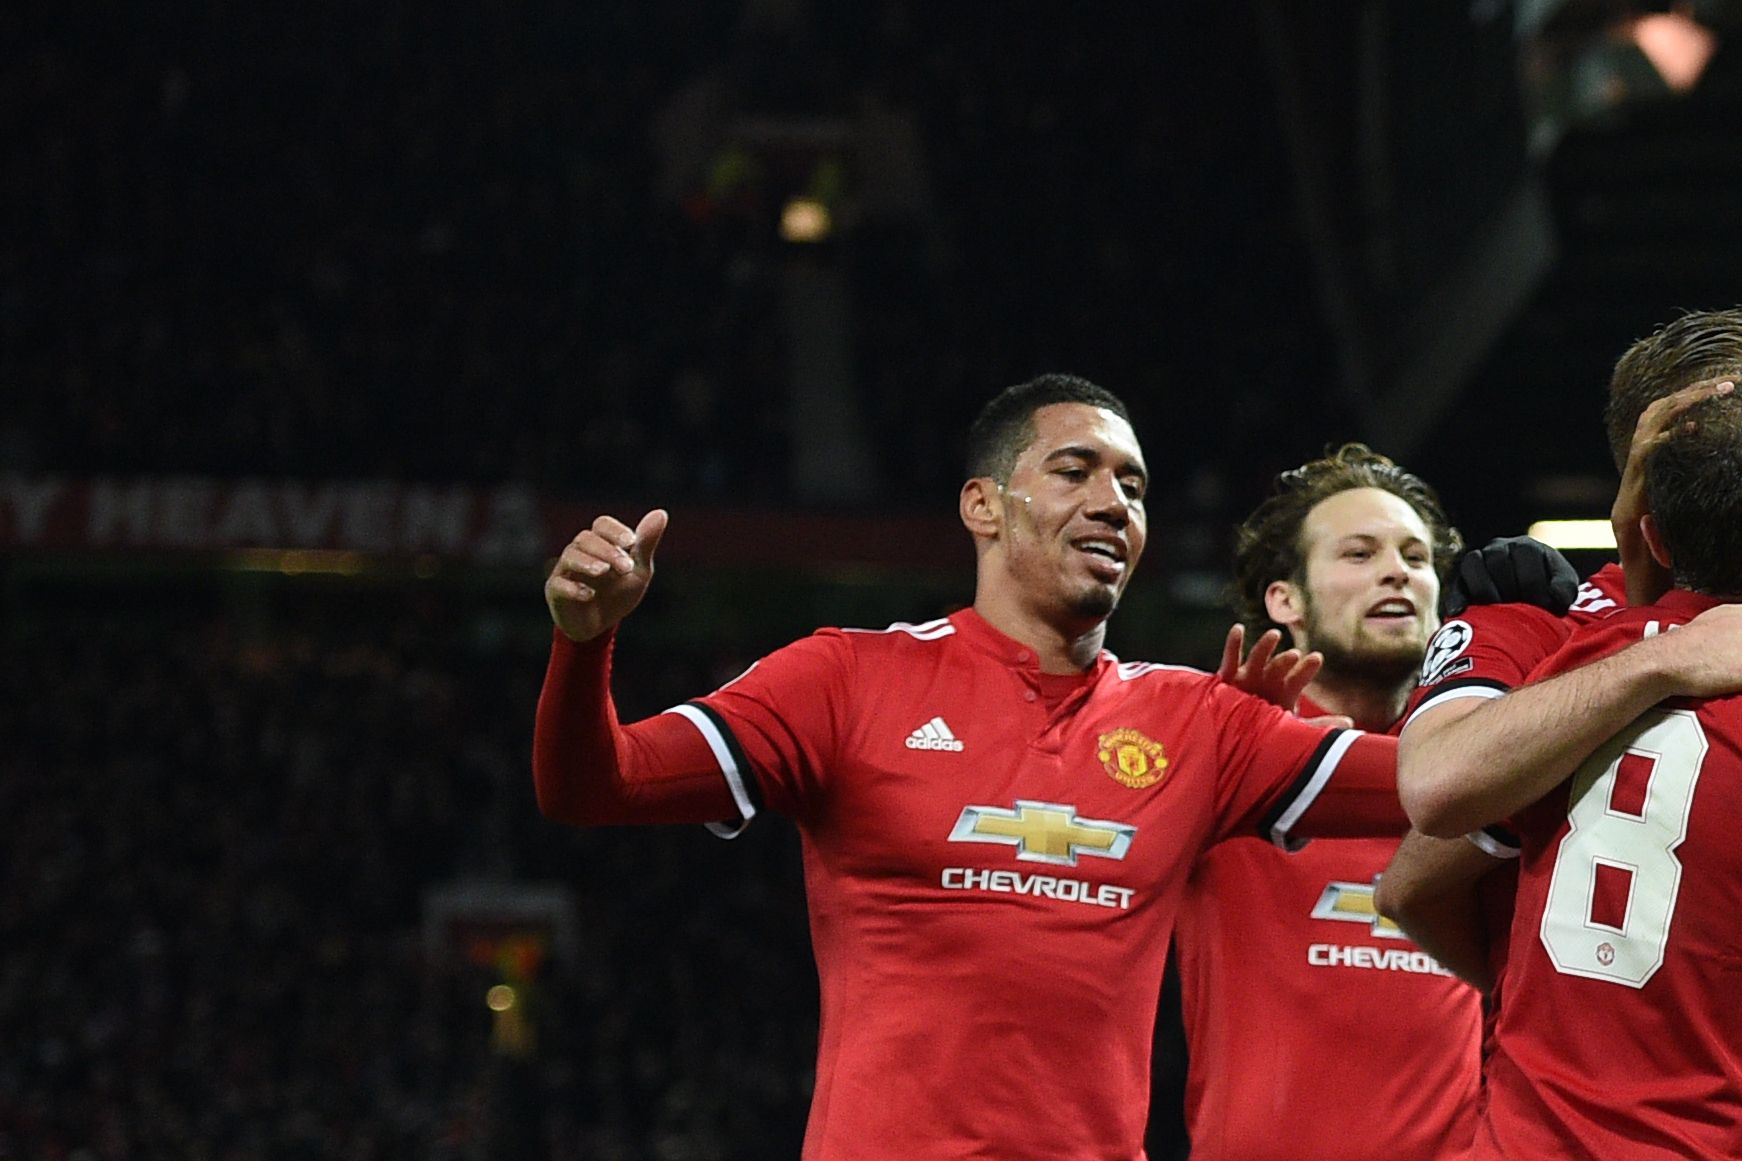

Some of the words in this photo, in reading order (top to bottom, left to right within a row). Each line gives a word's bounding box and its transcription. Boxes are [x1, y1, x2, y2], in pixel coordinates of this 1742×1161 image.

[88, 477, 474, 553] HEAVEN
[905, 736, 964, 752] adidas
[1539, 710, 1709, 989] 8
[942, 868, 1135, 909] CHEVROLET
[1308, 943, 1457, 978] CHEVROL
